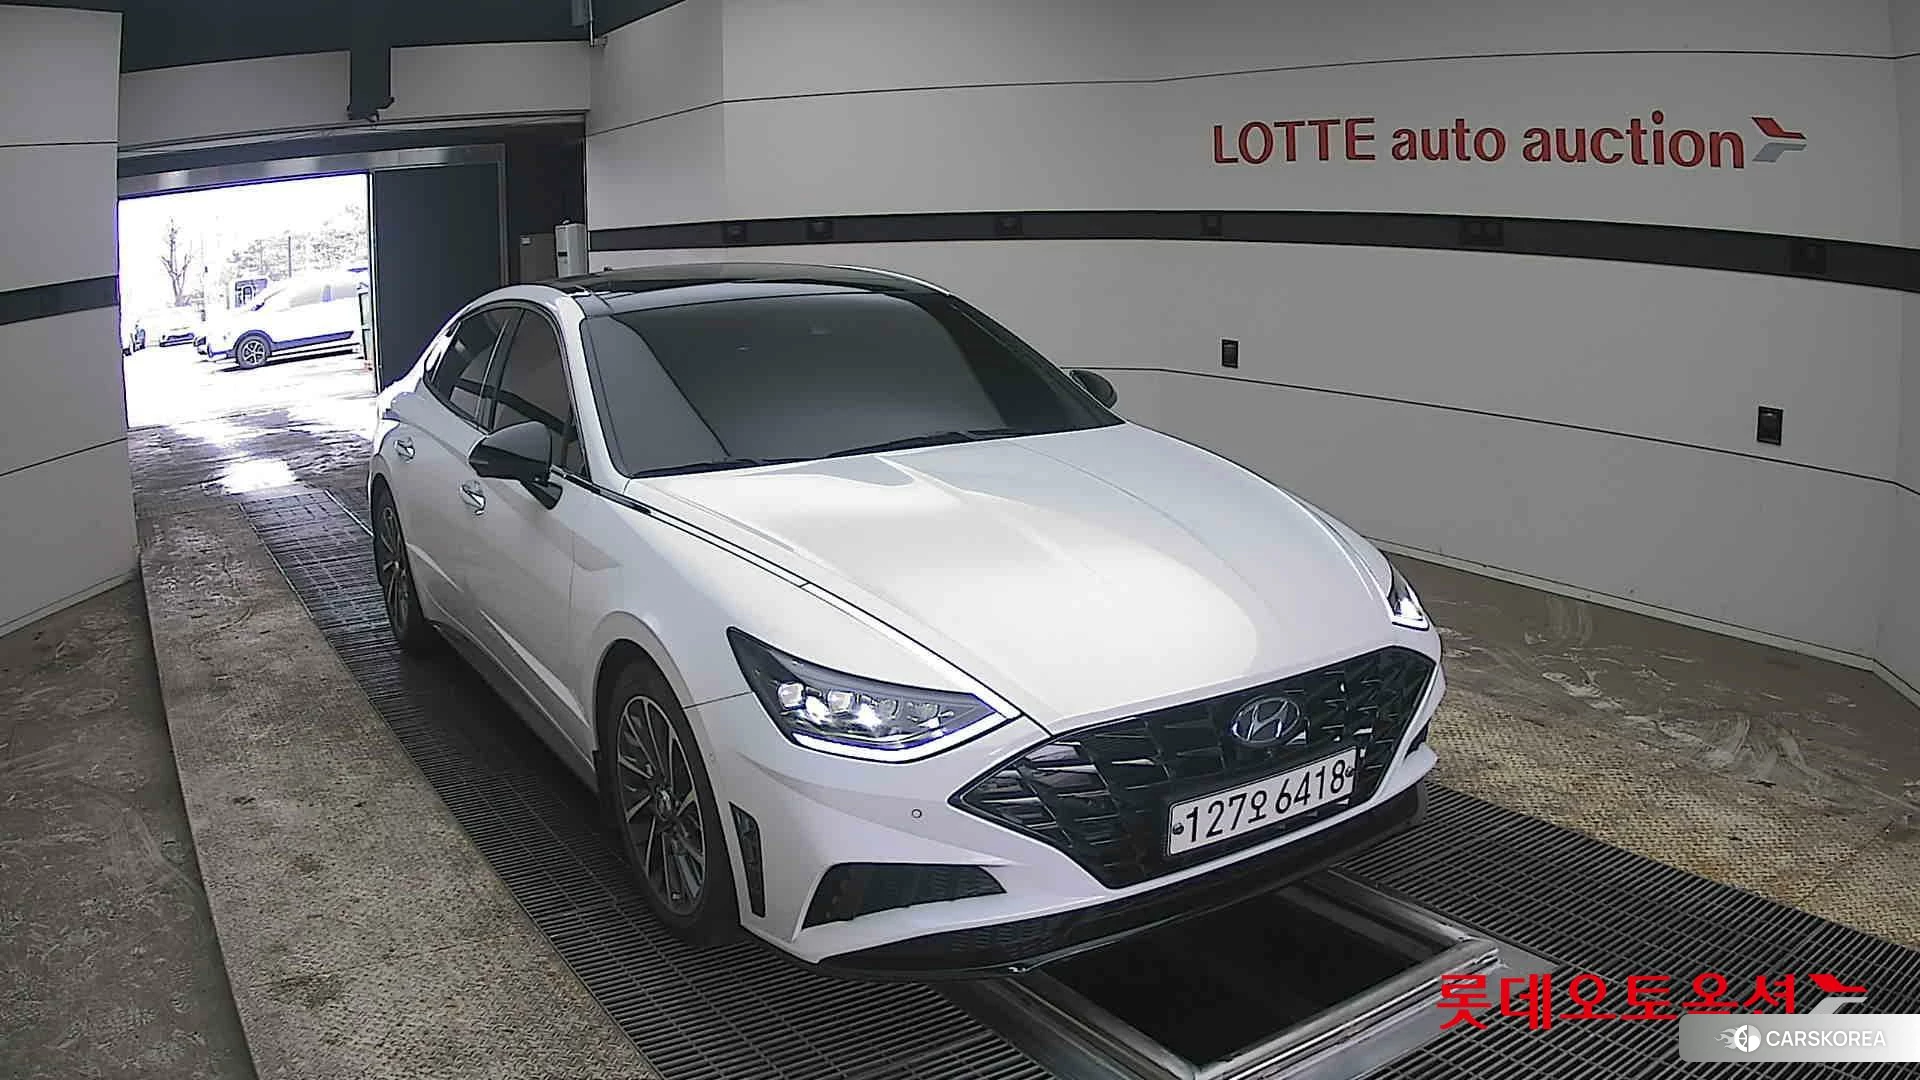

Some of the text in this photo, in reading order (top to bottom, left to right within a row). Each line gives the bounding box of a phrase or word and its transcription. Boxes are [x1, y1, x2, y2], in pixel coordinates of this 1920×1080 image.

[1213, 110, 1745, 169] LOTTE auto auction
[1186, 759, 1346, 843] 127오 6418
